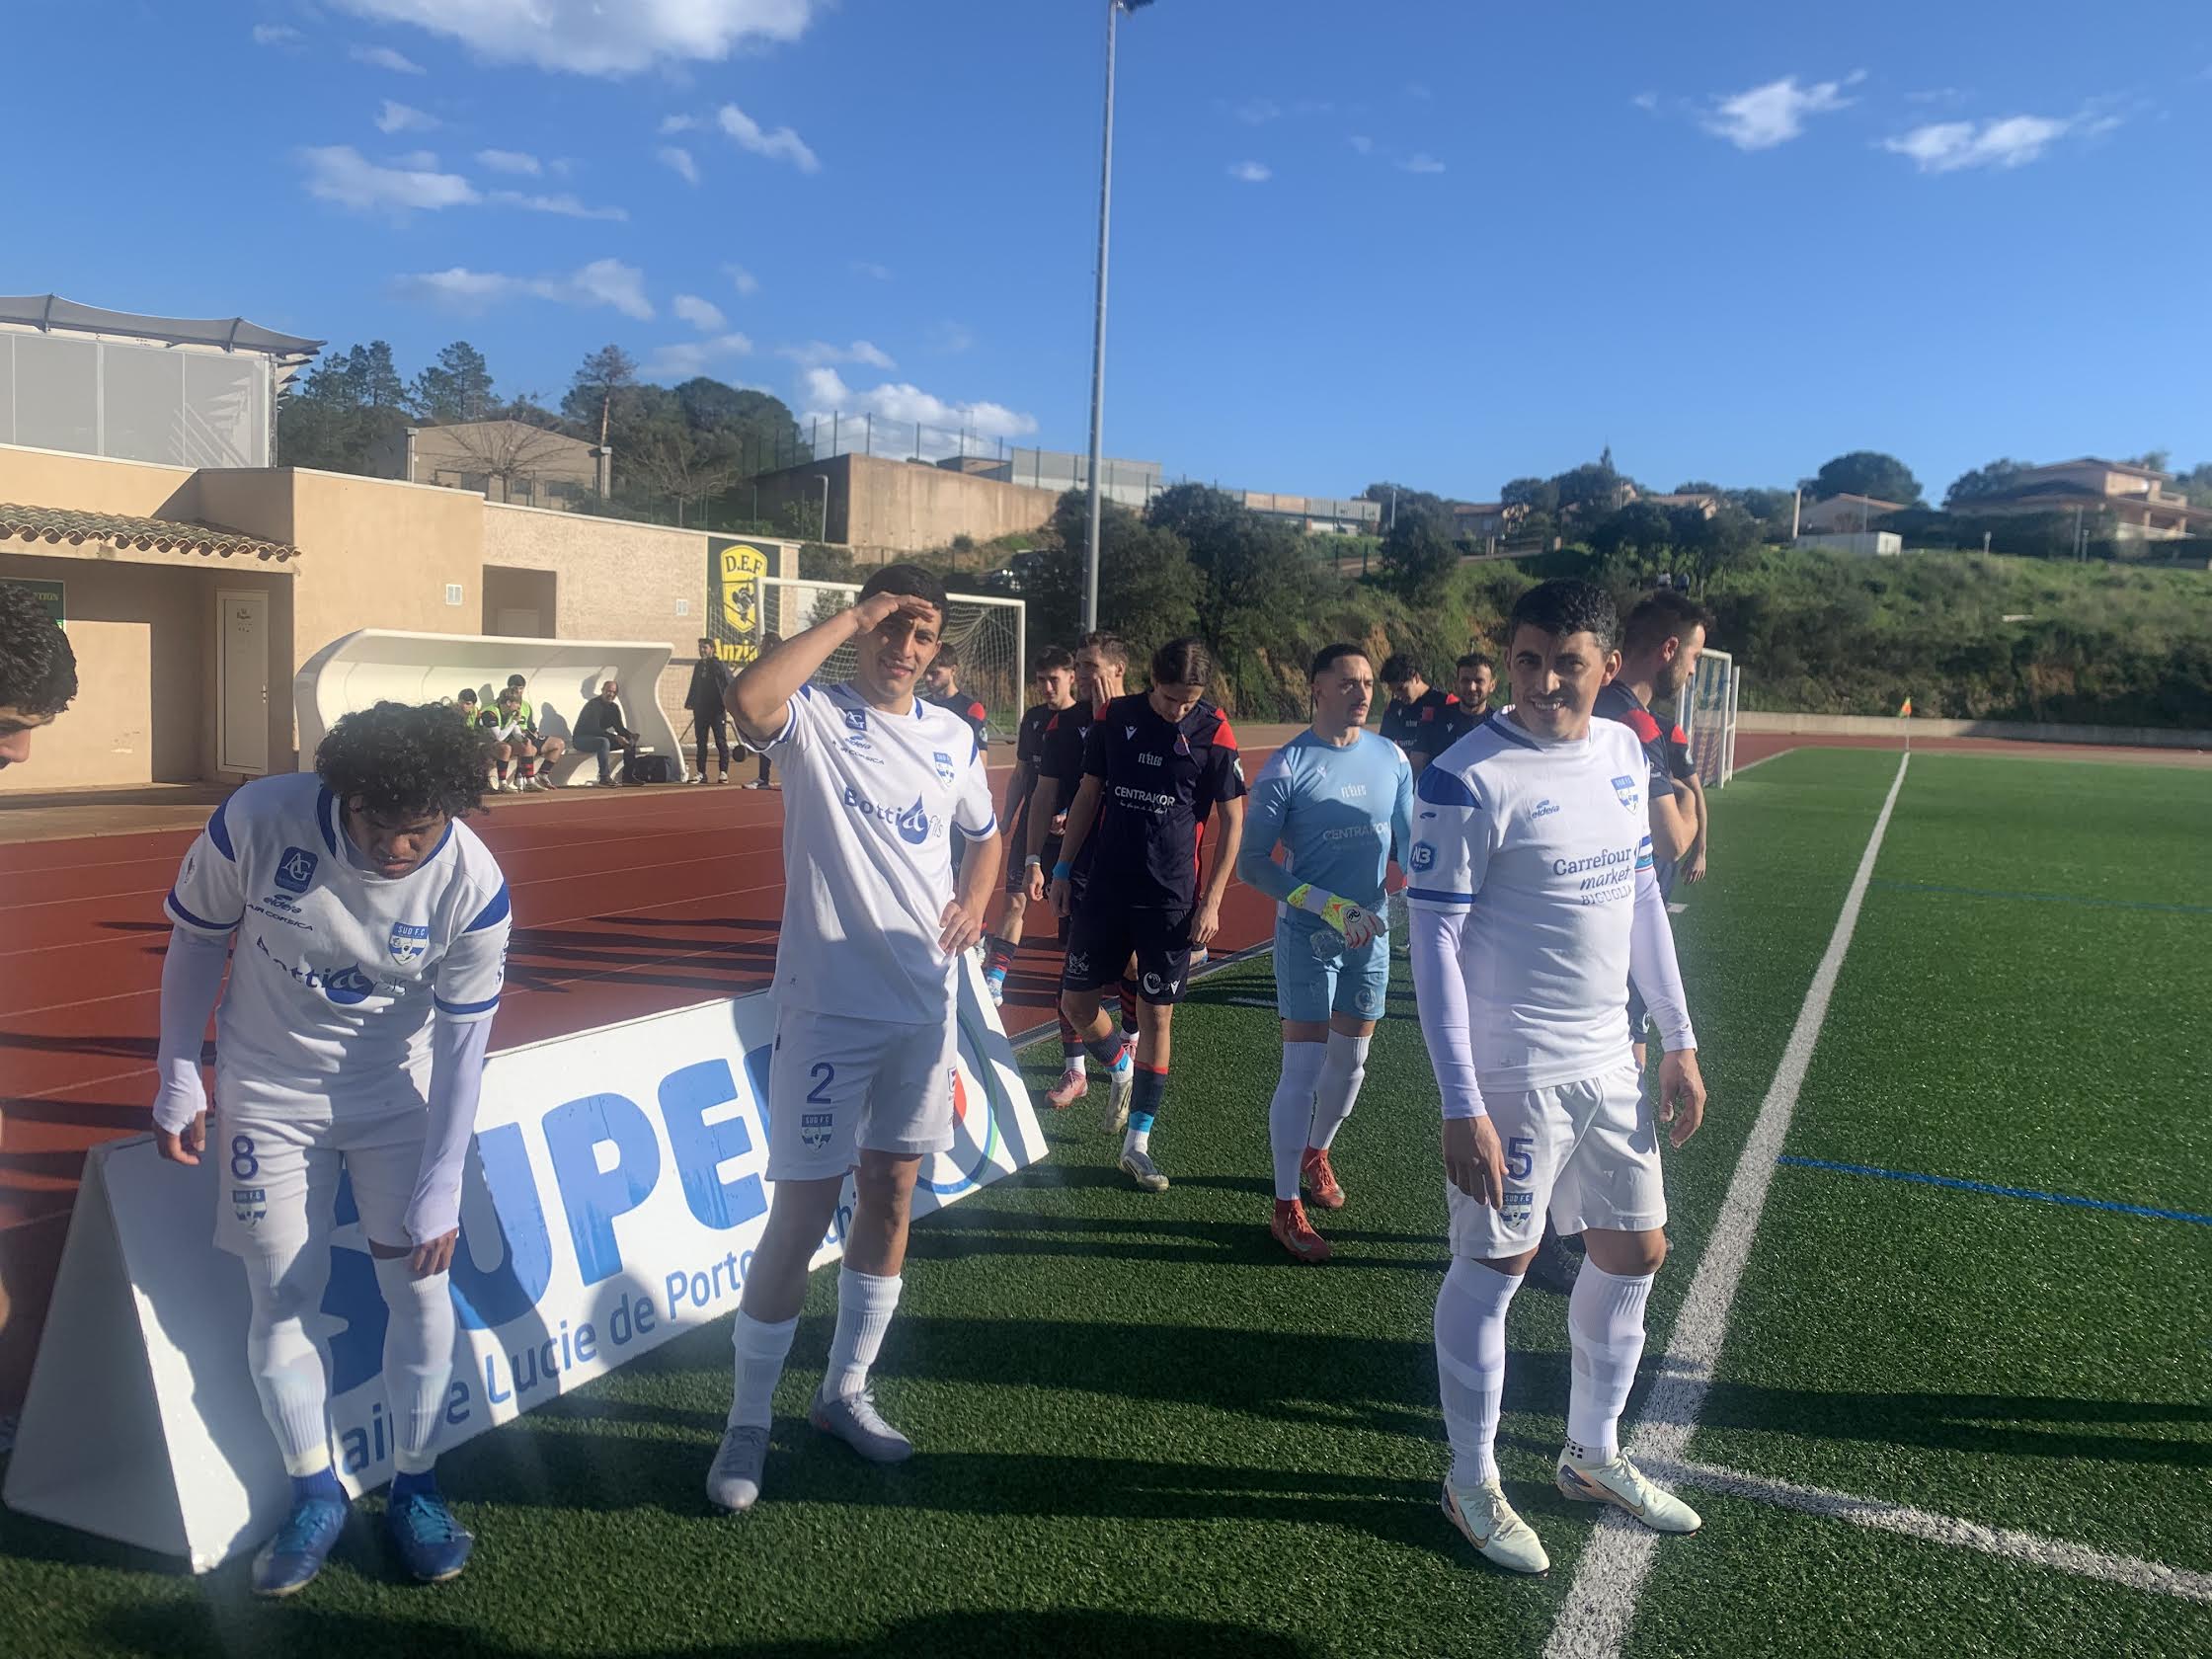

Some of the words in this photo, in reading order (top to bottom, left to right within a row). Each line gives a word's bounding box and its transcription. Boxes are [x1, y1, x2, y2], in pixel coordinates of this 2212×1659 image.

[1114, 786, 1176, 807] CENTRAKOR
[1532, 805, 1560, 820] eldera
[1411, 845, 1432, 864] N3
[1552, 848, 1631, 877] Carrefour
[1579, 865, 1631, 891] market
[247, 903, 265, 914] AIR
[265, 910, 314, 931] CORSICA
[263, 896, 302, 913] eldera
[397, 925, 413, 935] SUD
[806, 1062, 835, 1105] 2
[805, 1115, 819, 1125] SUD
[230, 1135, 259, 1180] 8
[1508, 1137, 1535, 1181] 5
[1504, 1194, 1519, 1203] SUD
[320, 1044, 770, 1397] UPE
[485, 1319, 597, 1405] Lucie
[609, 1292, 657, 1346] de
